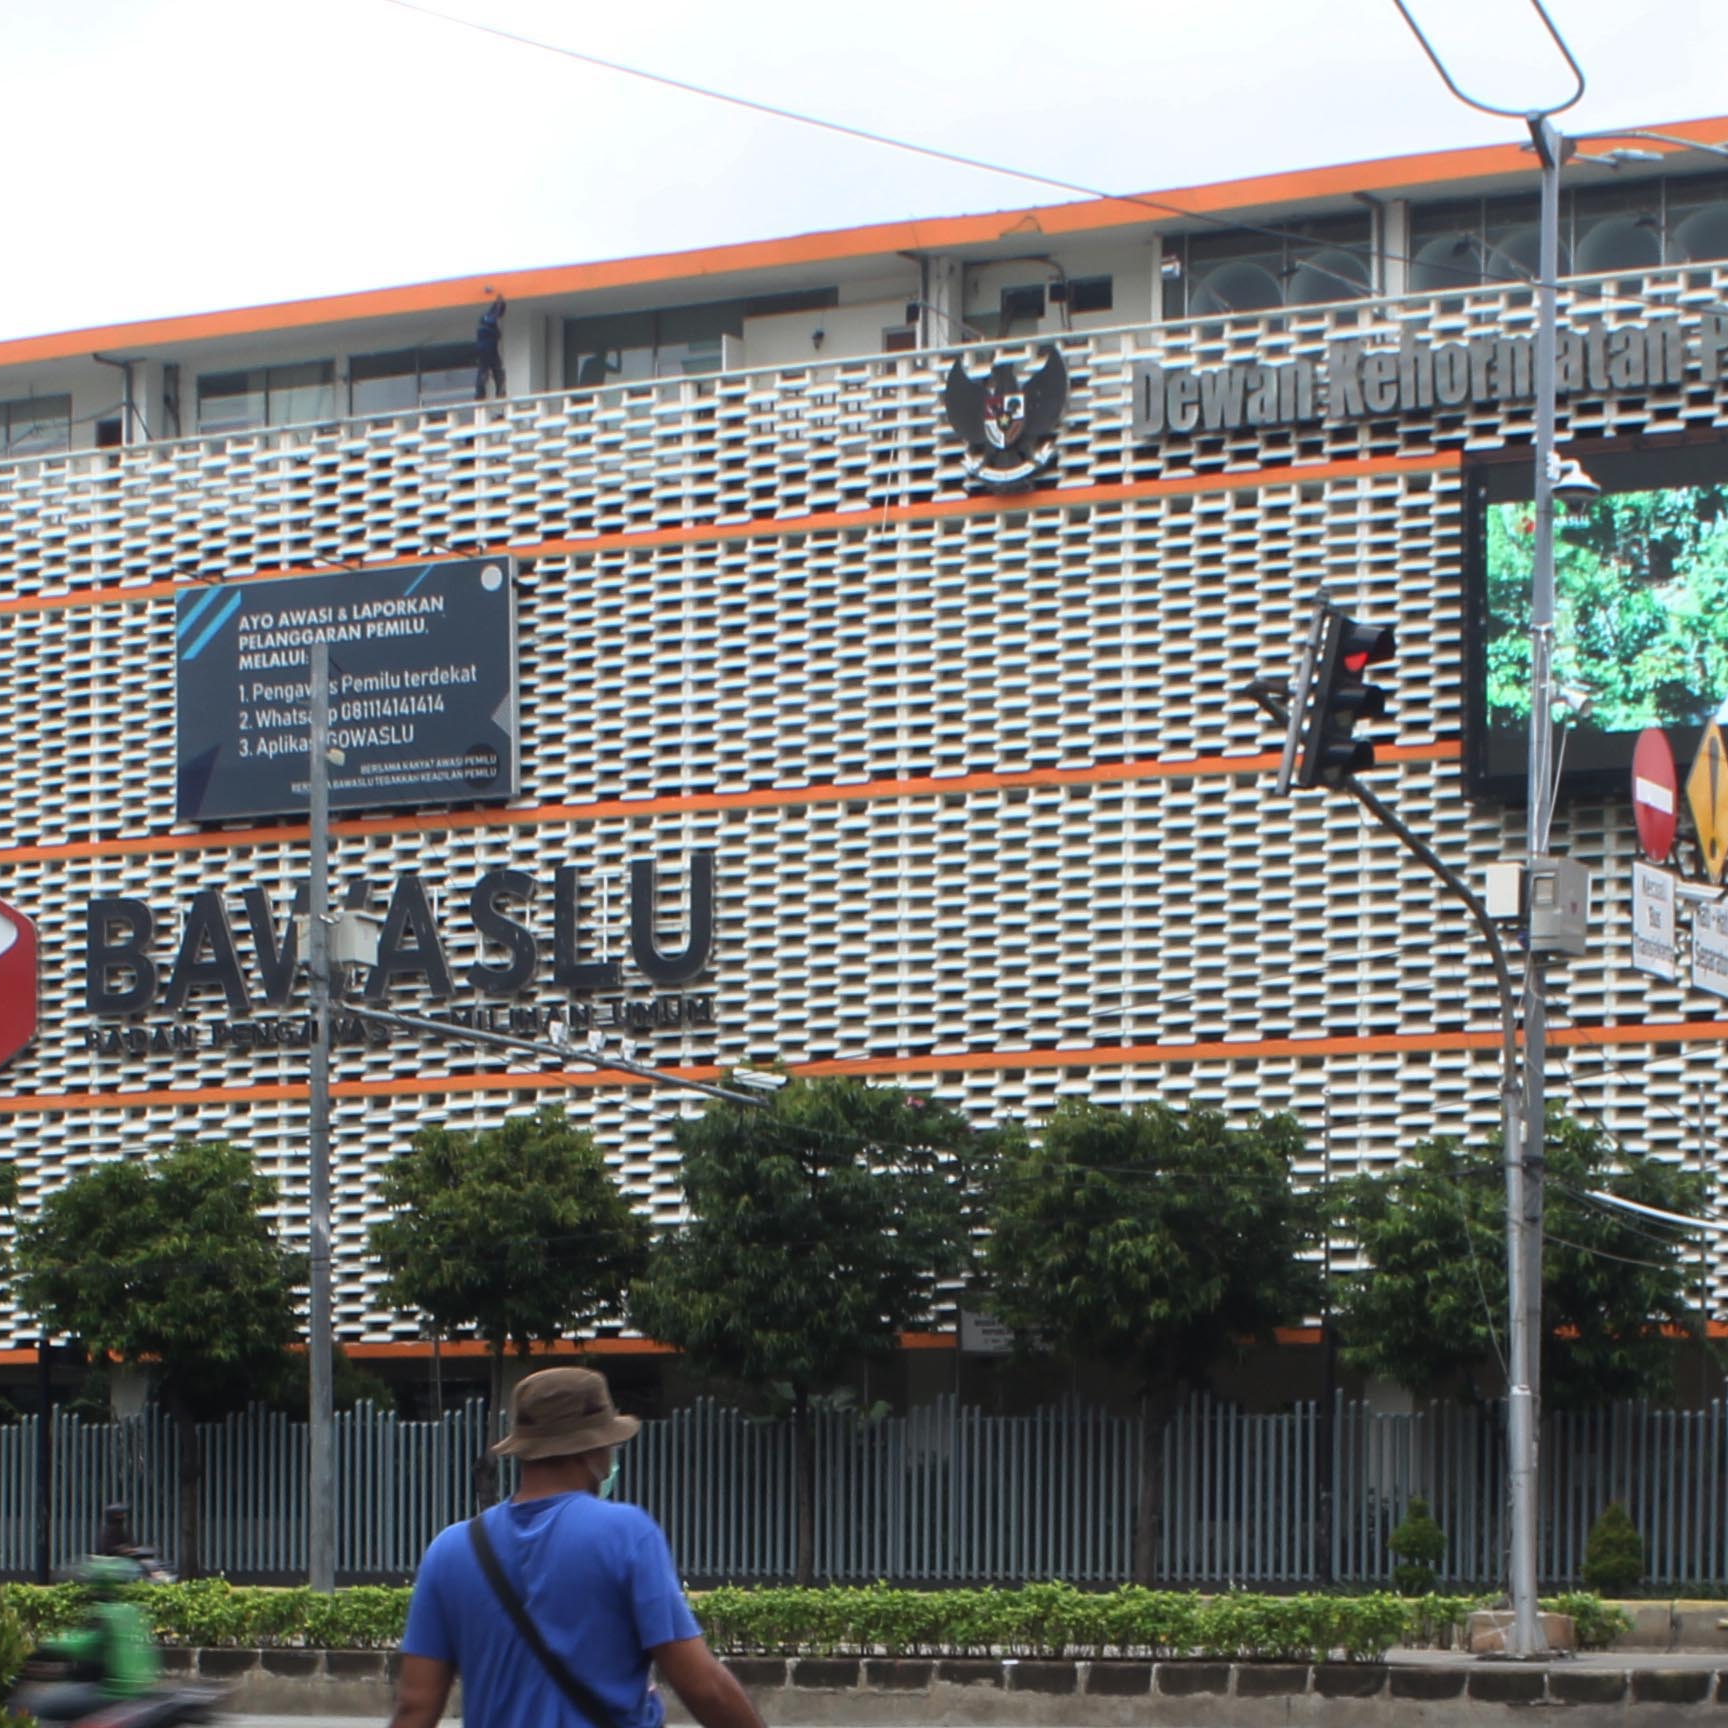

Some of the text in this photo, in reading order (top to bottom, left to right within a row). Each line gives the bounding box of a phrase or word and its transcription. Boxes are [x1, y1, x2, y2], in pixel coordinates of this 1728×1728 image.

[1132, 358, 1313, 436] Dewan
[1328, 319, 1682, 420] Kehormatan
[239, 595, 444, 632] AYO AWASI & LAPORKAN
[239, 626, 362, 651] PELANGGARAN
[238, 684, 249, 703] 1.
[342, 668, 400, 694] Pemilu
[404, 664, 478, 688] terdekat
[239, 711, 252, 730] 2.
[239, 738, 253, 758] 3.
[465, 754, 497, 767] PEMILU
[465, 767, 497, 779] PEMILU
[85, 1024, 196, 1051] BADAN
